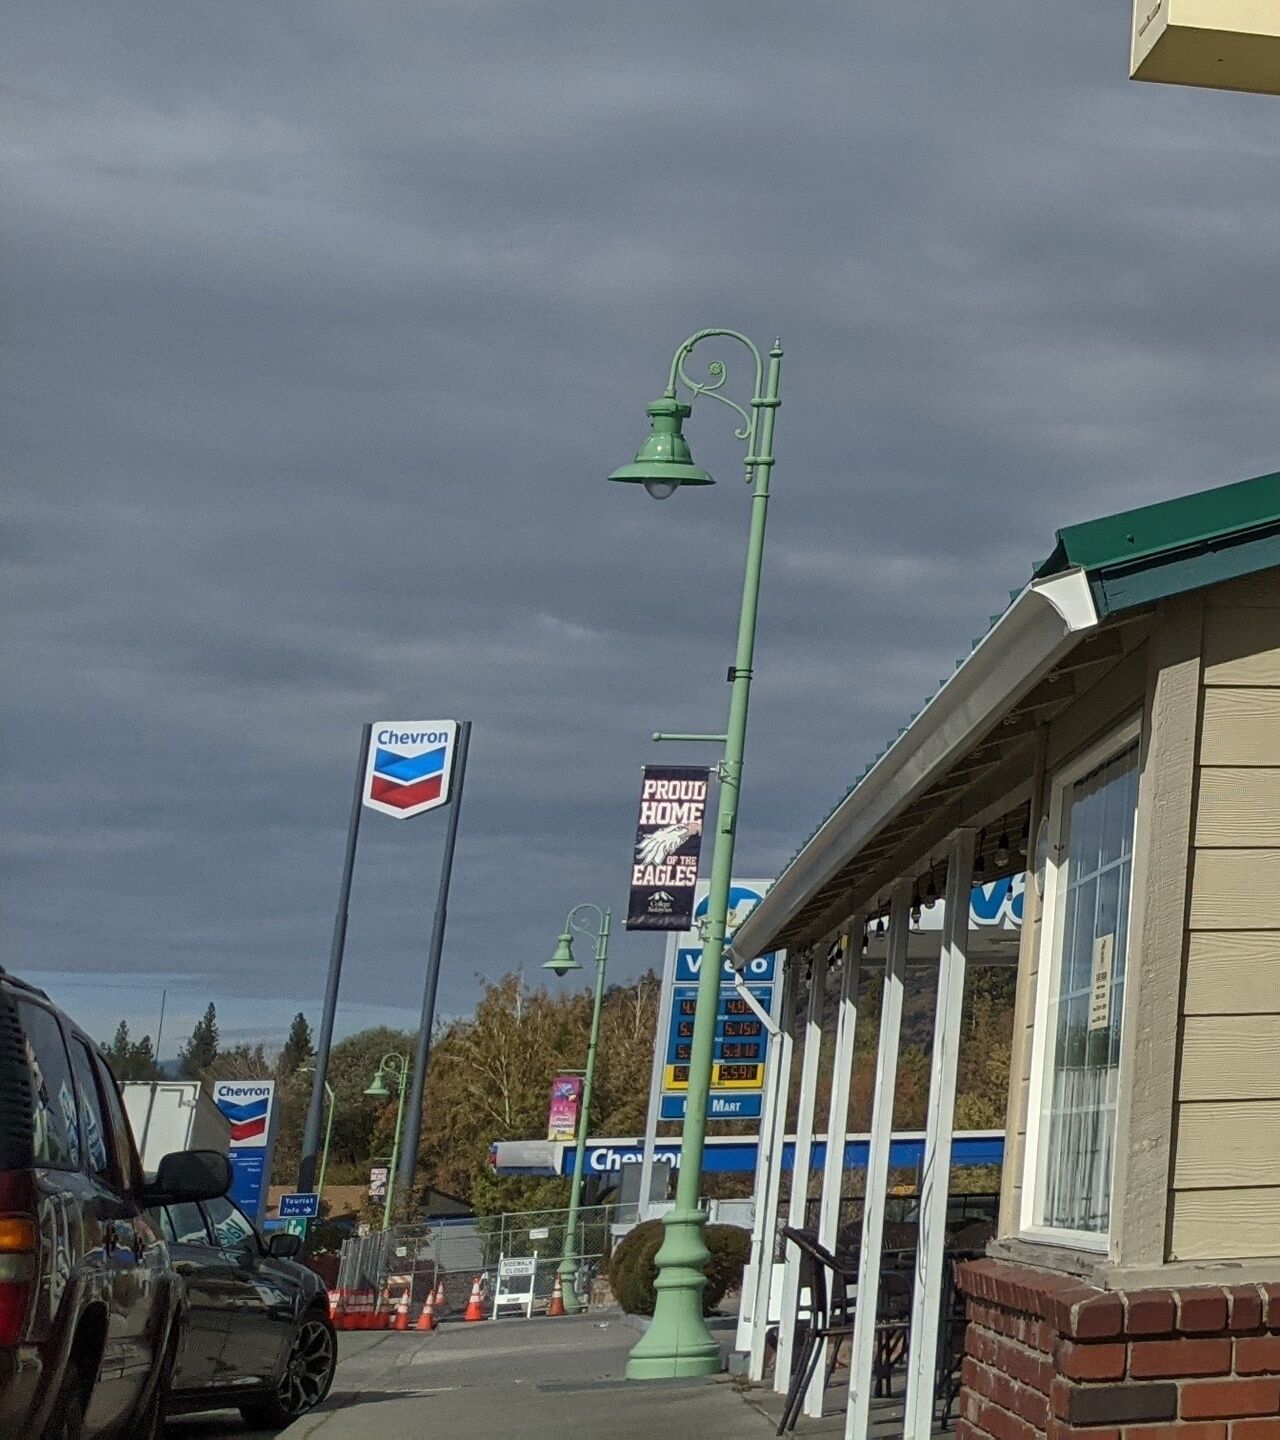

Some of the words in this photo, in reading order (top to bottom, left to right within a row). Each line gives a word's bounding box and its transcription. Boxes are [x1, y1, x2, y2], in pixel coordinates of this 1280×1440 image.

[377, 729, 449, 745] Chevron
[642, 779, 707, 800] PROUD
[639, 801, 704, 825] HOME
[666, 855, 678, 865] OF
[680, 855, 697, 866] THE
[632, 864, 696, 887] EAGLES
[217, 1085, 271, 1098] Chevron
[285, 1197, 314, 1205] Tourist
[283, 1206, 300, 1214] Info
